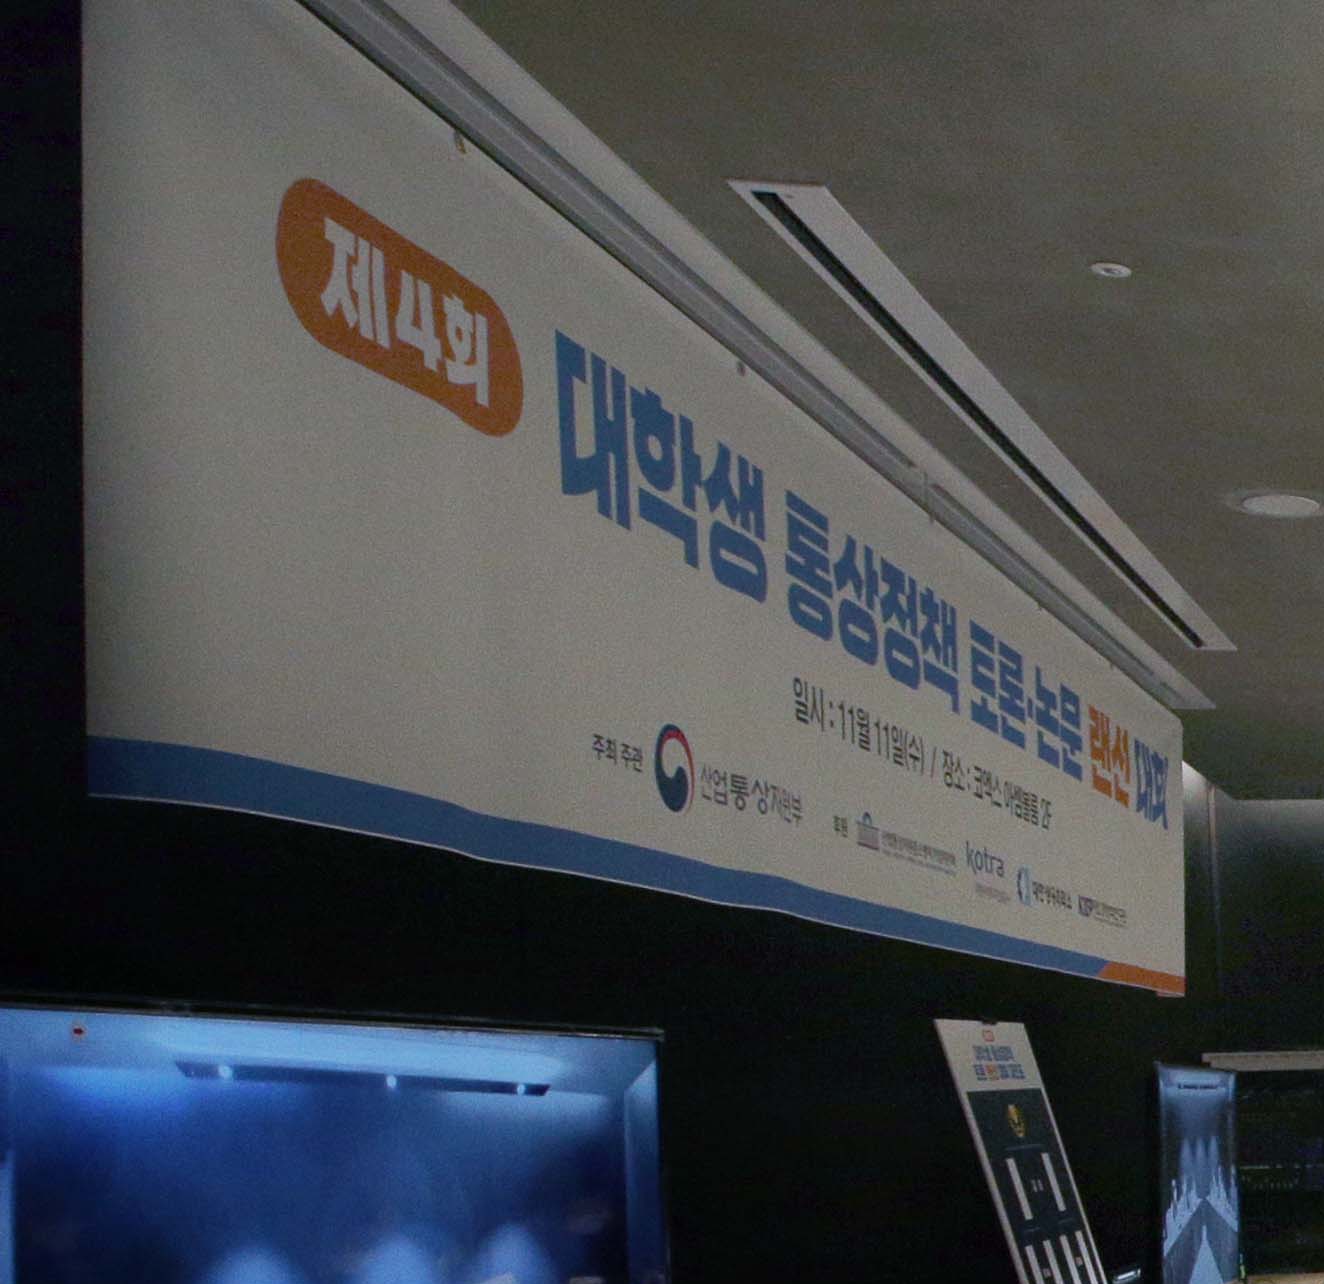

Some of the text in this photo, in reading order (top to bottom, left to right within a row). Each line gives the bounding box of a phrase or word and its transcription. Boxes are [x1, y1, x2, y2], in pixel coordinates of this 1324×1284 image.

[554, 328, 768, 604] 대학생
[784, 488, 960, 715] 통상정책
[1088, 703, 1131, 809] 랜선
[1133, 737, 1169, 830] 대회
[792, 676, 825, 733] 일시
[837, 700, 871, 752] 11월
[873, 715, 925, 777] 11일(수)
[942, 748, 966, 792] 장소
[965, 840, 1006, 878] kotra
